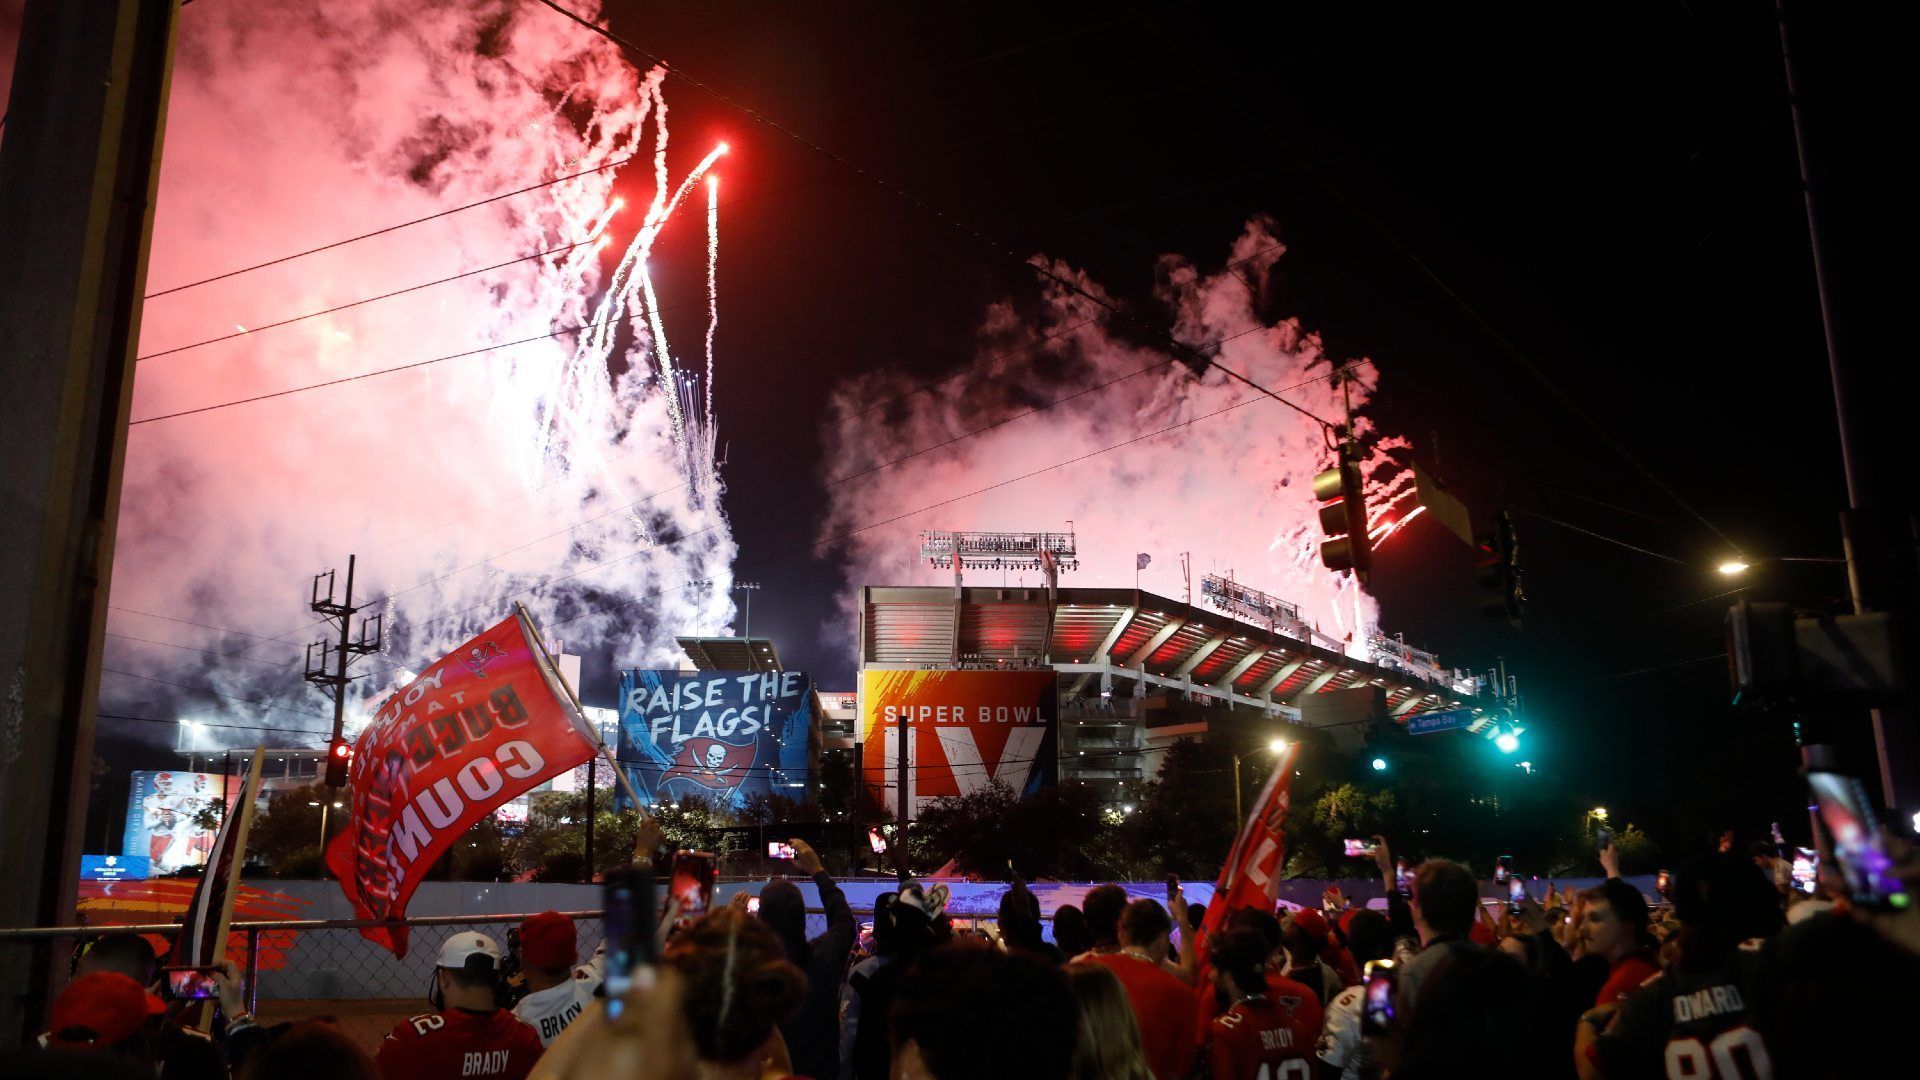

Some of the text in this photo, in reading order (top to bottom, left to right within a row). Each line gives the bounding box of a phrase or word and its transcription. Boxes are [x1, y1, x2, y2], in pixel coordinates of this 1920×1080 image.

[623, 671, 802, 718] RAISE THE
[884, 705, 1047, 723] SUPER BOWL
[650, 704, 772, 745] FLAGS!
[1417, 718, 1441, 729] Tampa
[1442, 715, 1456, 725] Bay
[884, 726, 1047, 821] LV
[541, 1001, 583, 1040] BRADY
[1673, 984, 1745, 1024] OWARD
[1259, 1027, 1294, 1051] BRADY
[462, 1049, 510, 1077] BRADY
